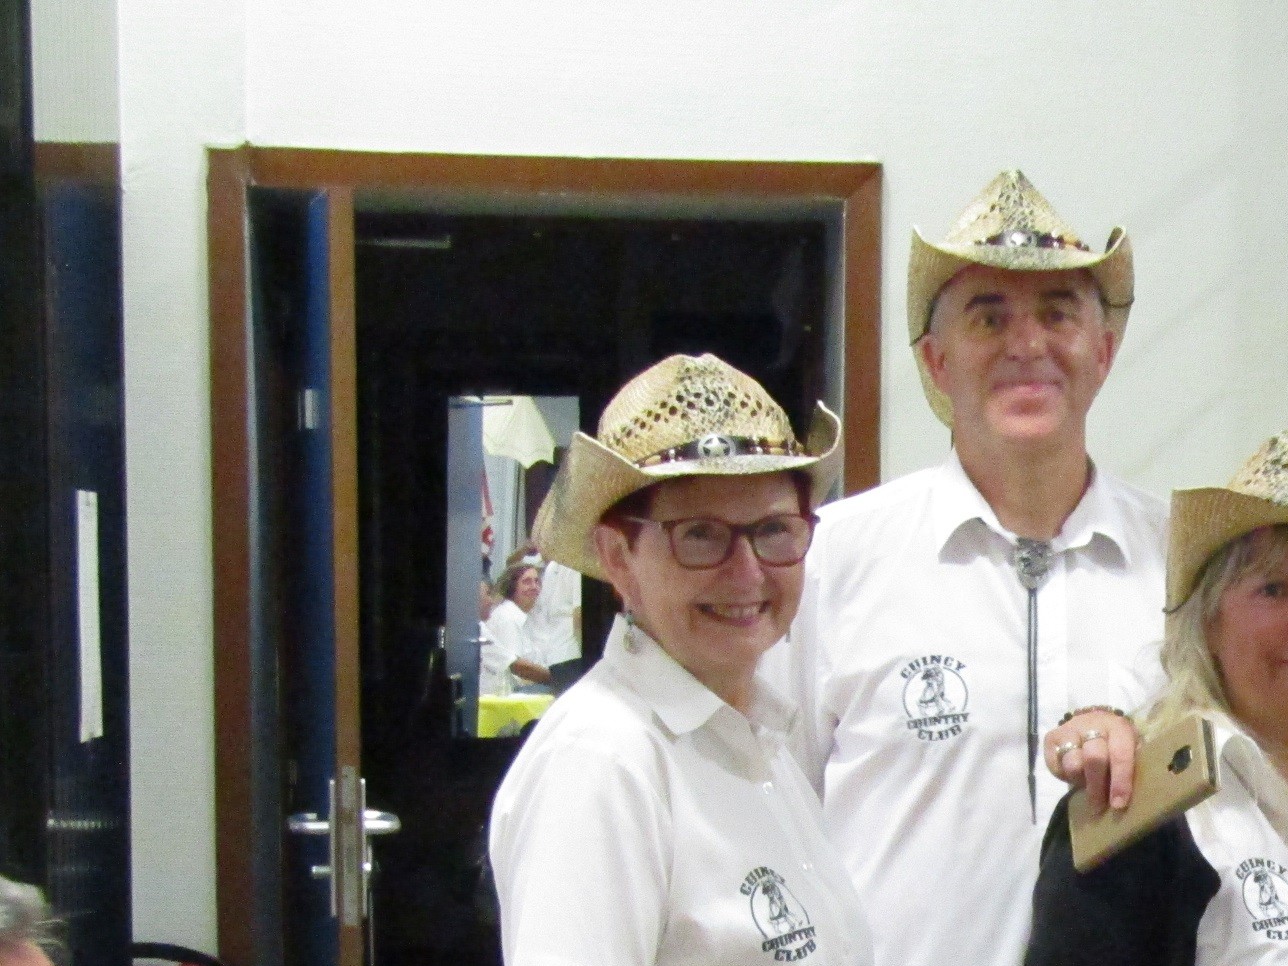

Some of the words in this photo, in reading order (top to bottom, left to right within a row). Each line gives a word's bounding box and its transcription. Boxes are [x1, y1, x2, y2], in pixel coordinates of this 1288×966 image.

[900, 655, 966, 679] CUINCY
[907, 712, 969, 729] COUNTRY
[918, 725, 962, 741] CLUB
[1236, 858, 1287, 880] CUINCY
[762, 926, 816, 952] COUNTRY
[774, 939, 816, 962] CLUB
